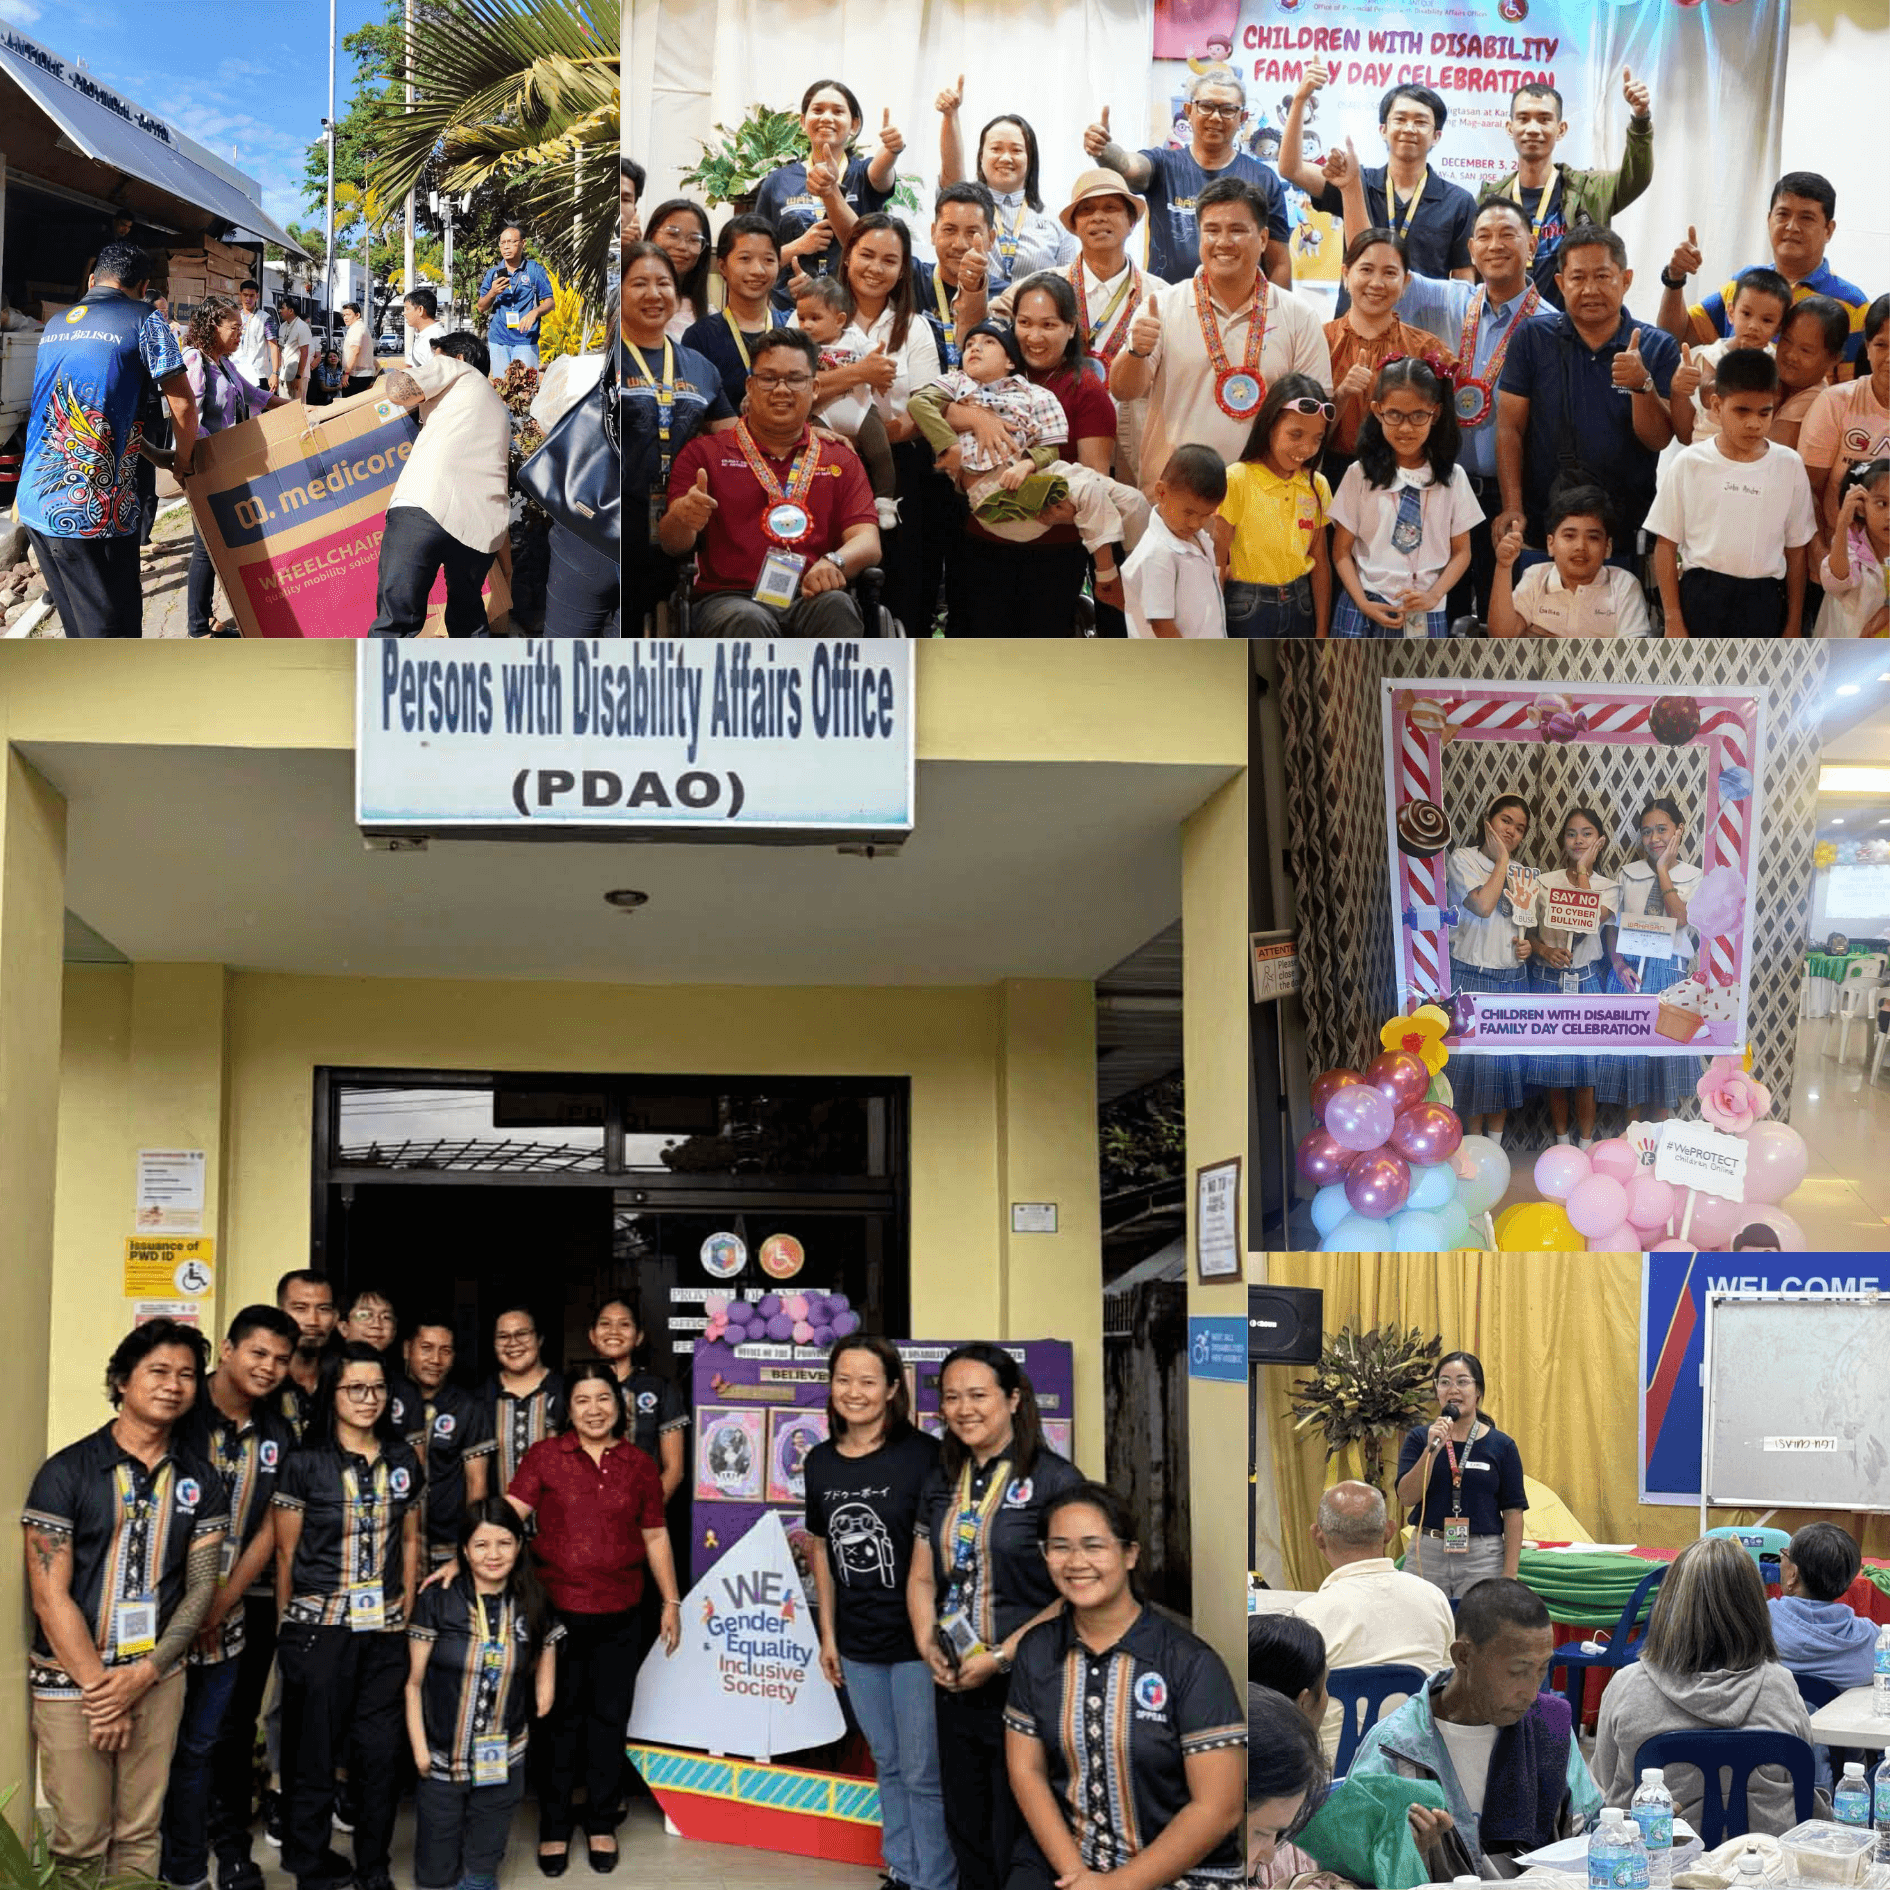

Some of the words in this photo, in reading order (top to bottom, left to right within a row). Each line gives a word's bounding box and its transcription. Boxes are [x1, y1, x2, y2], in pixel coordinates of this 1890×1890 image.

[1243, 24, 1360, 53] CHILDREN
[1368, 27, 1424, 56] WITH
[1430, 31, 1559, 63] DISABILITY
[1254, 58, 1342, 85] FAMY
[1348, 61, 1393, 87] DAY
[1442, 157, 1495, 169] DECEMBER
[281, 440, 414, 514] medicore
[303, 565, 347, 589] mobility
[381, 639, 494, 735] Persons
[502, 639, 564, 735] with
[572, 639, 703, 764] Disability
[710, 643, 803, 739] Affairs
[810, 642, 895, 739] Office
[512, 769, 745, 818] (PDAO)
[1551, 891, 1577, 904] SAY
[1578, 894, 1598, 906] NO
[1550, 916, 1594, 928] BULLYING
[1551, 906, 1563, 915] TO
[1565, 907, 1596, 919] CYBER
[1480, 1008, 1547, 1020] CHILDREN
[1547, 1009, 1581, 1021] WITH
[1584, 1010, 1651, 1021] DISABILITY
[1479, 1022, 1528, 1035] FAMILY
[1531, 1023, 1559, 1035] DAY
[1562, 1023, 1651, 1035] CELEBRATION
[1666, 1140, 1739, 1168] #WePROTECT
[129, 1240, 184, 1251] Issuance
[186, 1240, 201, 1251] of
[129, 1250, 159, 1261] PWD
[161, 1250, 174, 1261] ID
[722, 1570, 783, 1610] WE
[707, 1610, 789, 1636] Gender
[726, 1633, 812, 1675] Equality
[719, 1653, 805, 1683] Inclusive
[723, 1674, 797, 1705] Society
